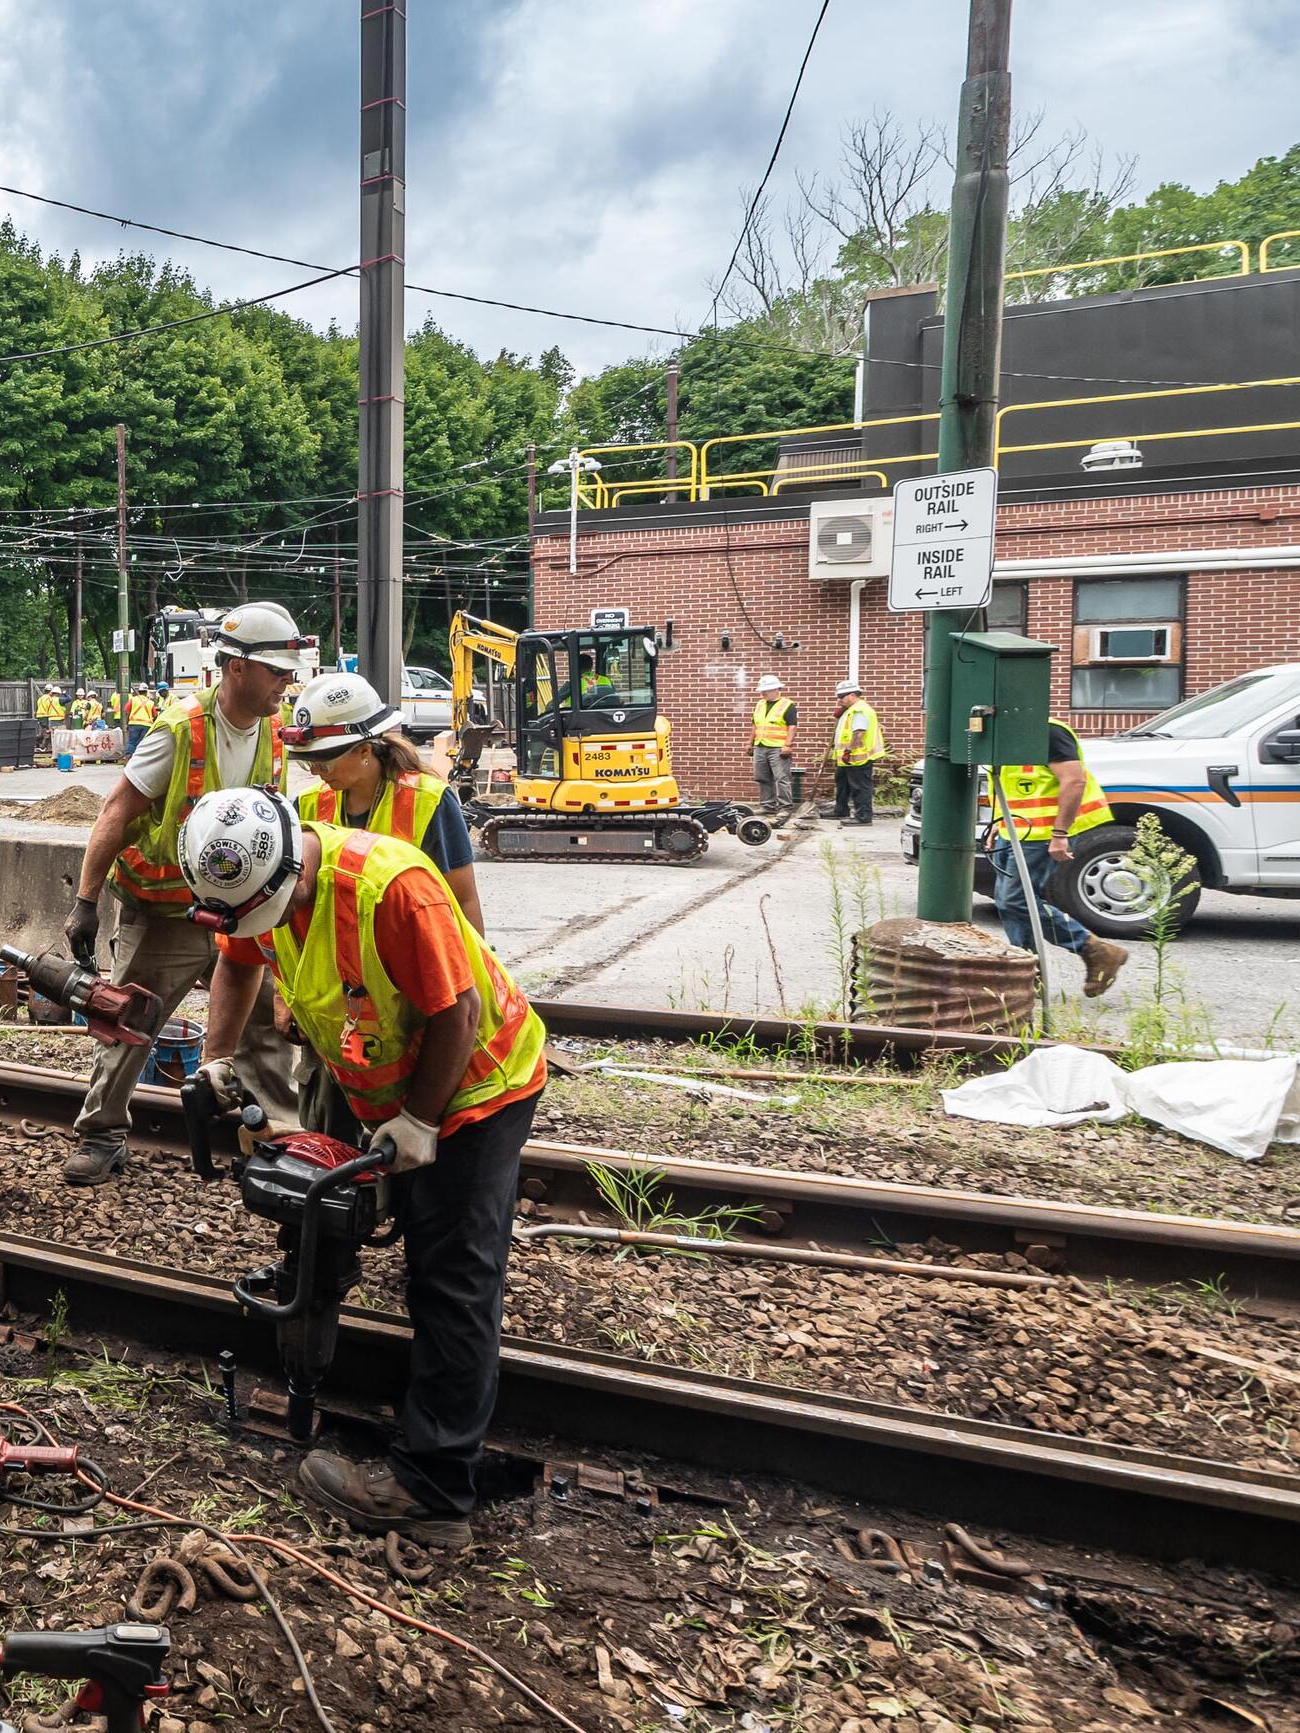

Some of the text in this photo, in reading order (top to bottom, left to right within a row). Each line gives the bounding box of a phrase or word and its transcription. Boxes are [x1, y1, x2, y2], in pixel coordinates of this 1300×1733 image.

[914, 481, 975, 502] OUTSIDE
[927, 499, 959, 516] RAIL
[915, 522, 944, 534] RIGHT
[917, 548, 964, 565] INSIDE
[923, 564, 956, 580] RAIL
[940, 586, 963, 597] LEFT
[476, 642, 502, 659] KOMATSU
[327, 688, 349, 702] 529
[584, 752, 611, 761] 2483
[595, 766, 650, 777] KOMATSU
[1019, 782, 1033, 792] T
[210, 840, 238, 851] BOWLS
[256, 831, 270, 860] 589
